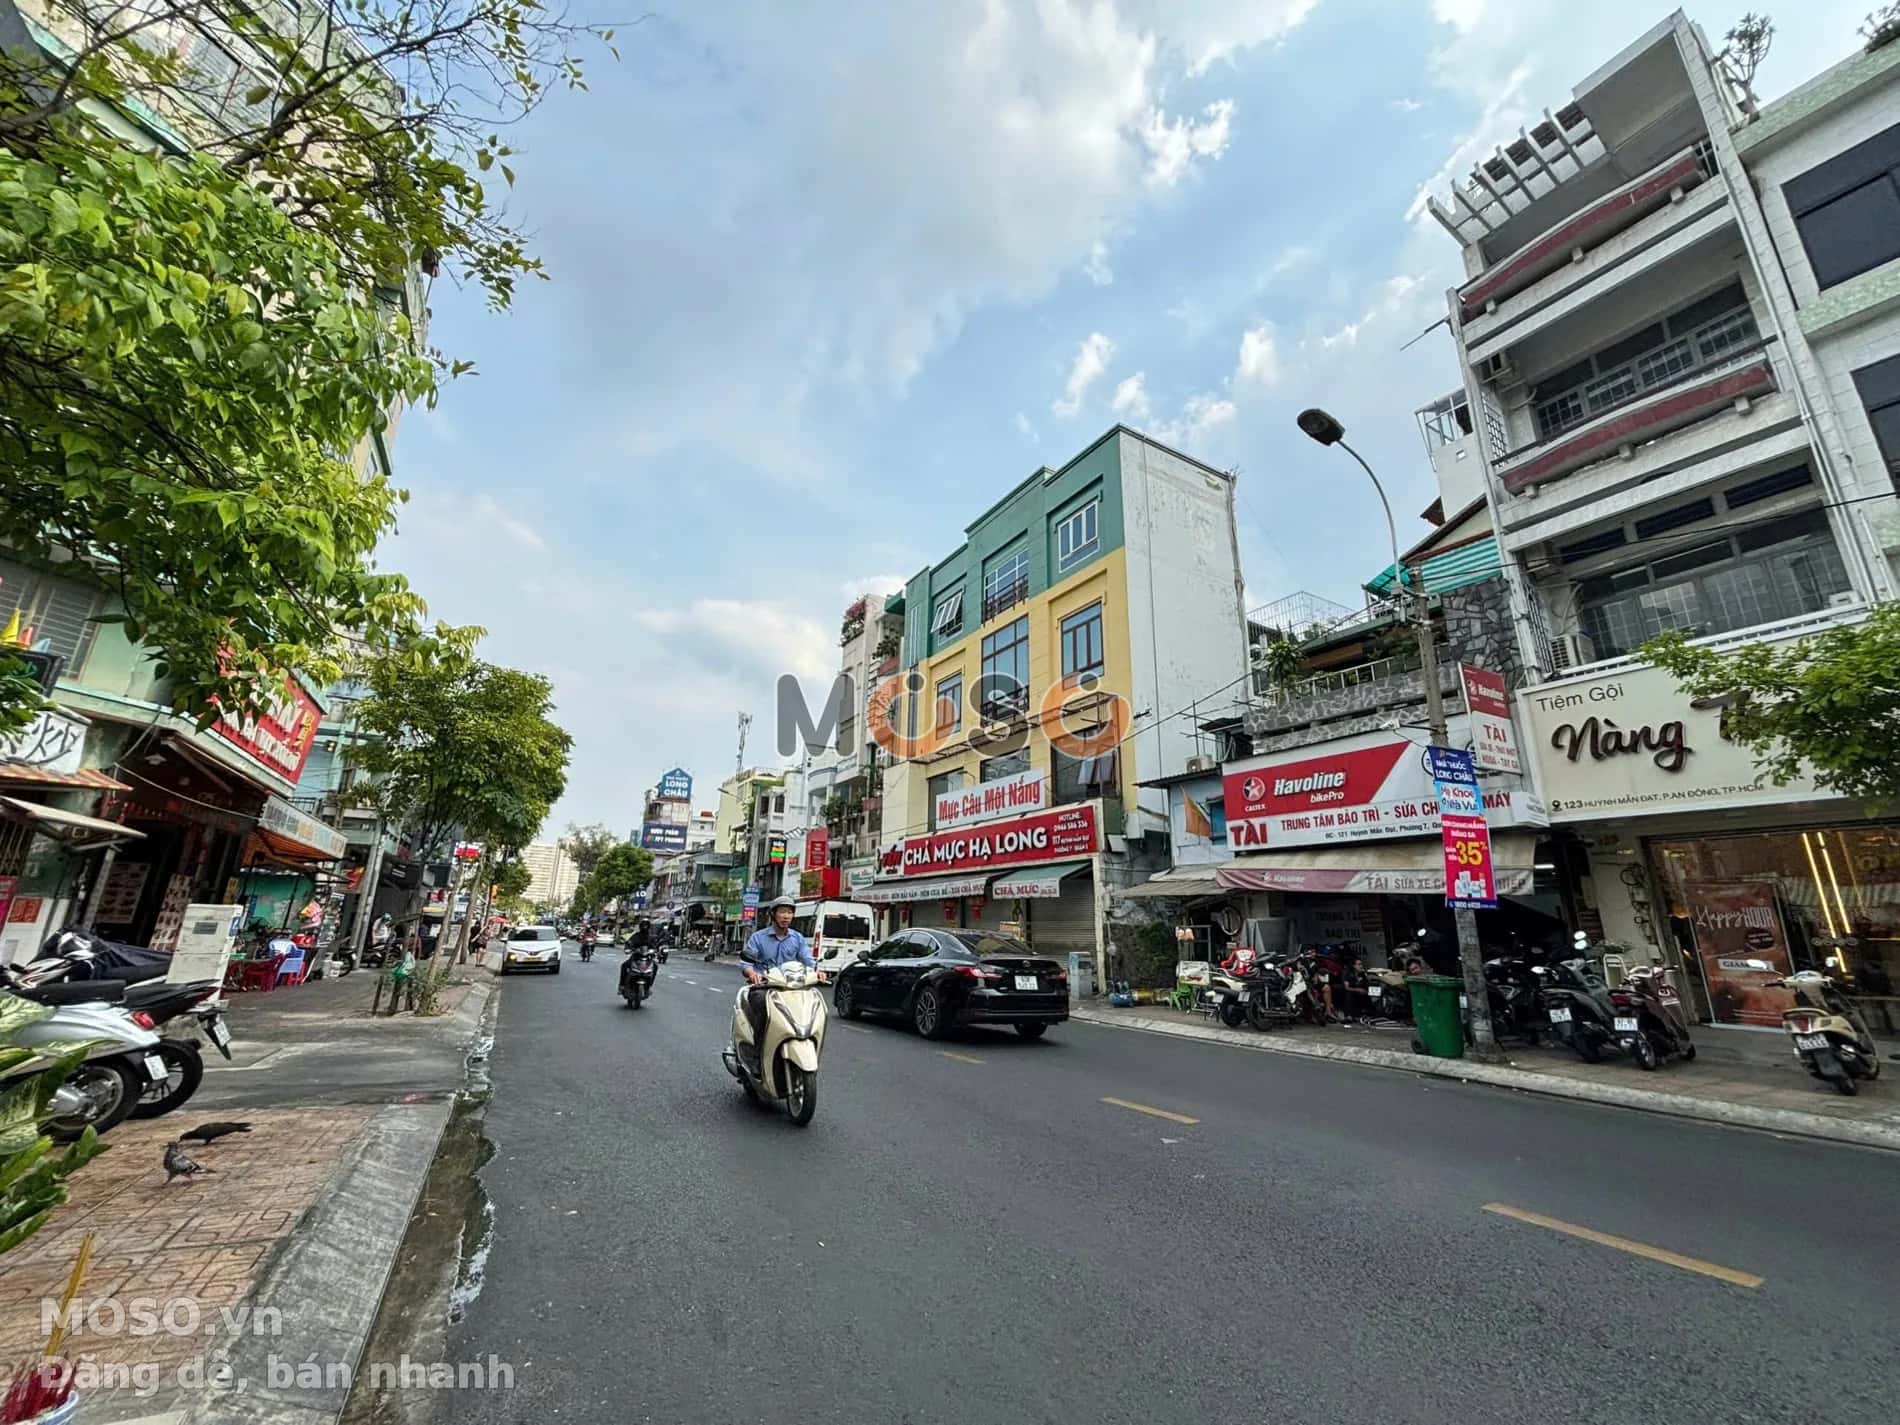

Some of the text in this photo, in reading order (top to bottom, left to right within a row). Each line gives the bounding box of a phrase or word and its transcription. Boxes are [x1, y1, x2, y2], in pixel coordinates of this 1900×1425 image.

[1536, 682, 1624, 713] Tiệm Gội
[1483, 723, 1507, 742] TÀI
[1551, 715, 1695, 773] Nàng
[1274, 771, 1346, 797] Havoline
[938, 775, 1040, 824] Mực Câu Một Nắng
[1244, 803, 1267, 812] CALTEX
[1310, 791, 1345, 804] bikePro
[1483, 790, 1511, 809] MÁY
[1564, 799, 1584, 810] 123
[1280, 817, 1311, 832] TRUNG
[1312, 813, 1334, 828] TÂM
[1338, 810, 1358, 825] BẢO
[1362, 806, 1380, 822] TRÌ
[1394, 800, 1418, 818] SỬA
[1230, 819, 1269, 848] TÀI
[904, 840, 931, 866] CHẢ
[934, 839, 965, 865] MỰC
[969, 837, 991, 861] HẠ
[996, 826, 1047, 854] LONG
[994, 883, 1015, 896] CHẢ
[1015, 883, 1039, 896] MỰC
[1367, 873, 1388, 890] TÀI
[1394, 874, 1416, 889] SỬA
[1742, 906, 1775, 929] HOUR
